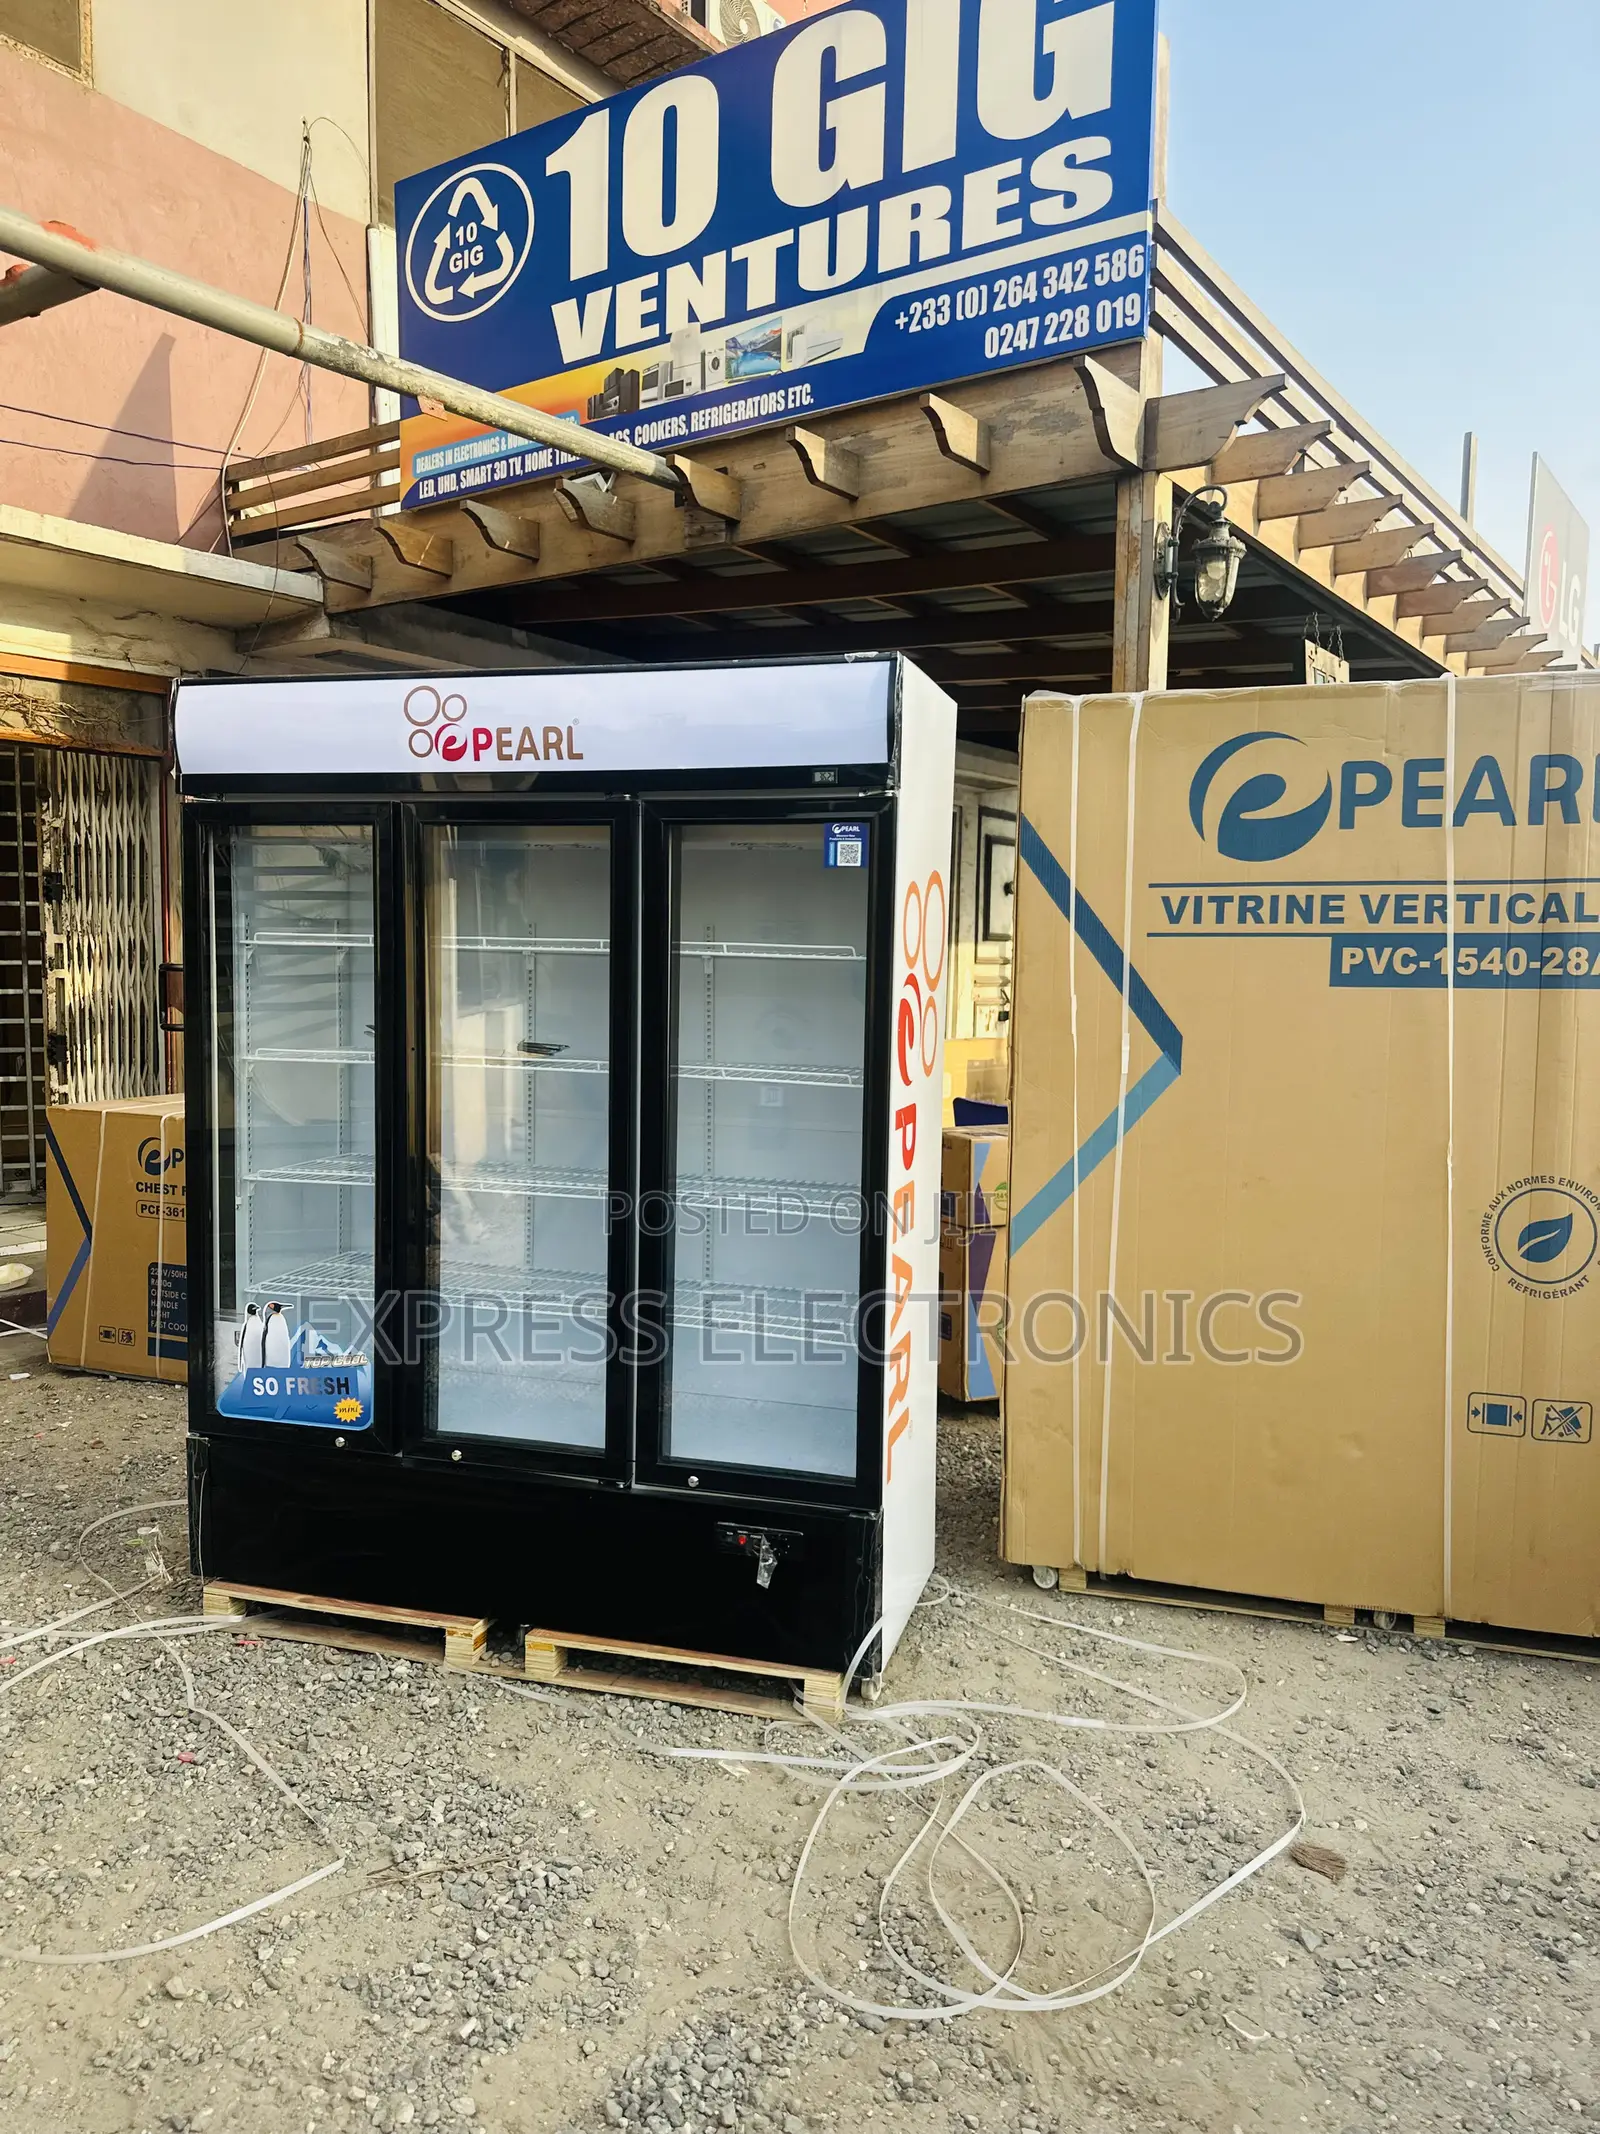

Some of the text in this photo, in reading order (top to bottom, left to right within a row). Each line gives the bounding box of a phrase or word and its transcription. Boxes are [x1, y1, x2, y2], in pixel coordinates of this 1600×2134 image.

[545, 0, 1114, 282] 10 GIG
[455, 221, 478, 247] 10
[449, 244, 484, 274] GIG
[551, 136, 1113, 364] VENTURES
[895, 294, 951, 334] +233
[993, 271, 1038, 313] 264
[1043, 258, 1089, 299] 342
[1095, 244, 1145, 287] 586
[984, 292, 1142, 360] 0247 228 019
[416, 454, 445, 474] DEALERS
[445, 453, 453, 465] IN
[453, 436, 500, 465] ELECTRONICS
[419, 480, 437, 500] LED,
[438, 474, 459, 495] UHD,
[460, 465, 493, 490] SMART
[494, 461, 508, 482] 3D
[509, 456, 524, 478] TV,
[525, 448, 553, 473] HOME
[634, 414, 689, 447] COOKERS,
[690, 389, 785, 433] REFRIGERATORS
[787, 383, 814, 409] ETC.
[1559, 559, 1582, 648] LG
[1161, 894, 1345, 925] VITRINE
[136, 1182, 178, 1196] CHEST
[1506, 1175, 1556, 1193] NORMES
[1488, 1190, 1508, 1213] AUX
[1480, 1212, 1500, 1272] CONFORME
[1507, 1275, 1590, 1300] REFRIGÉRANT
[303, 1353, 368, 1369] TOP COOL
[252, 1376, 350, 1397] SO FRESH
[338, 1405, 358, 1414] mini
